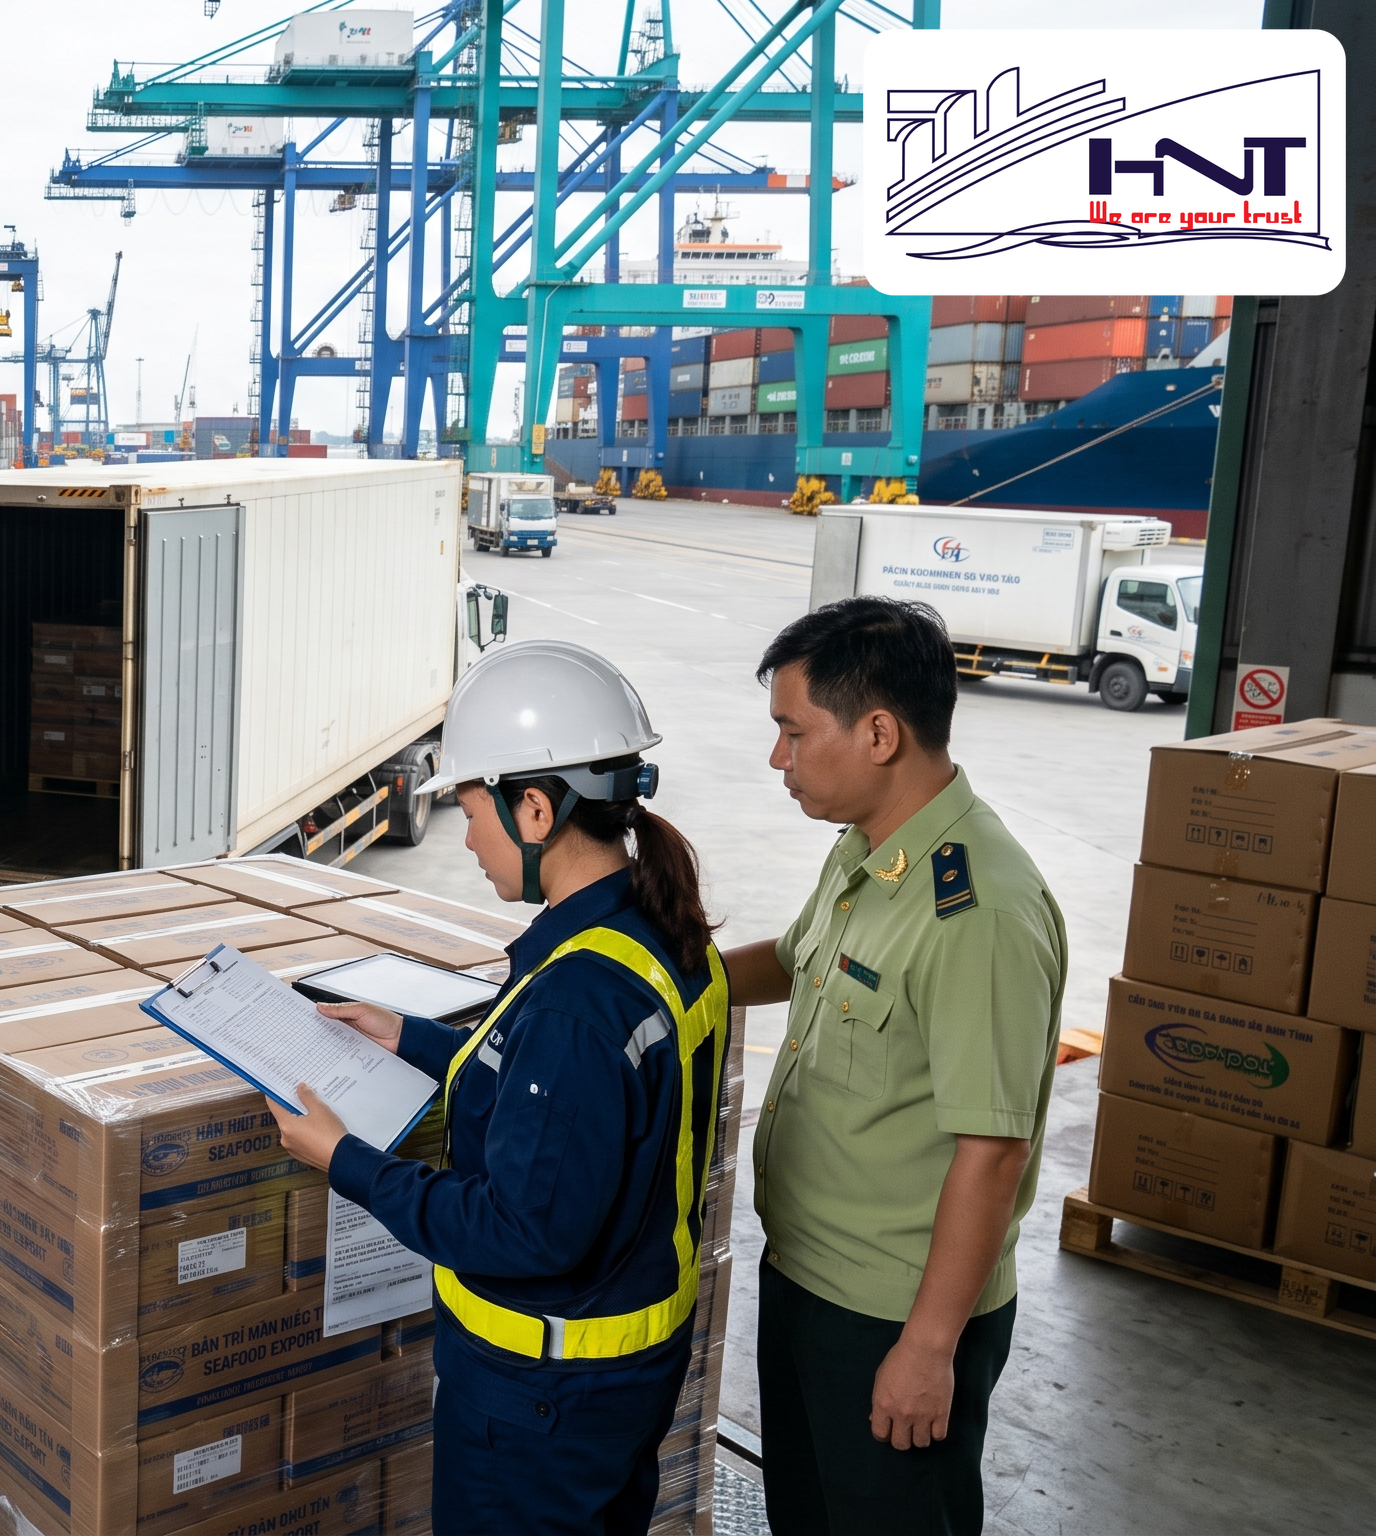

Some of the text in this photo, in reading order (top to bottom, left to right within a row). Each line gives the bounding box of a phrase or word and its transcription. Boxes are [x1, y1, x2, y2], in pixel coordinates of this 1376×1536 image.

[208, 1134, 272, 1162] SEAFOOD
[204, 1327, 323, 1376] SEAFOOD EXPORT
